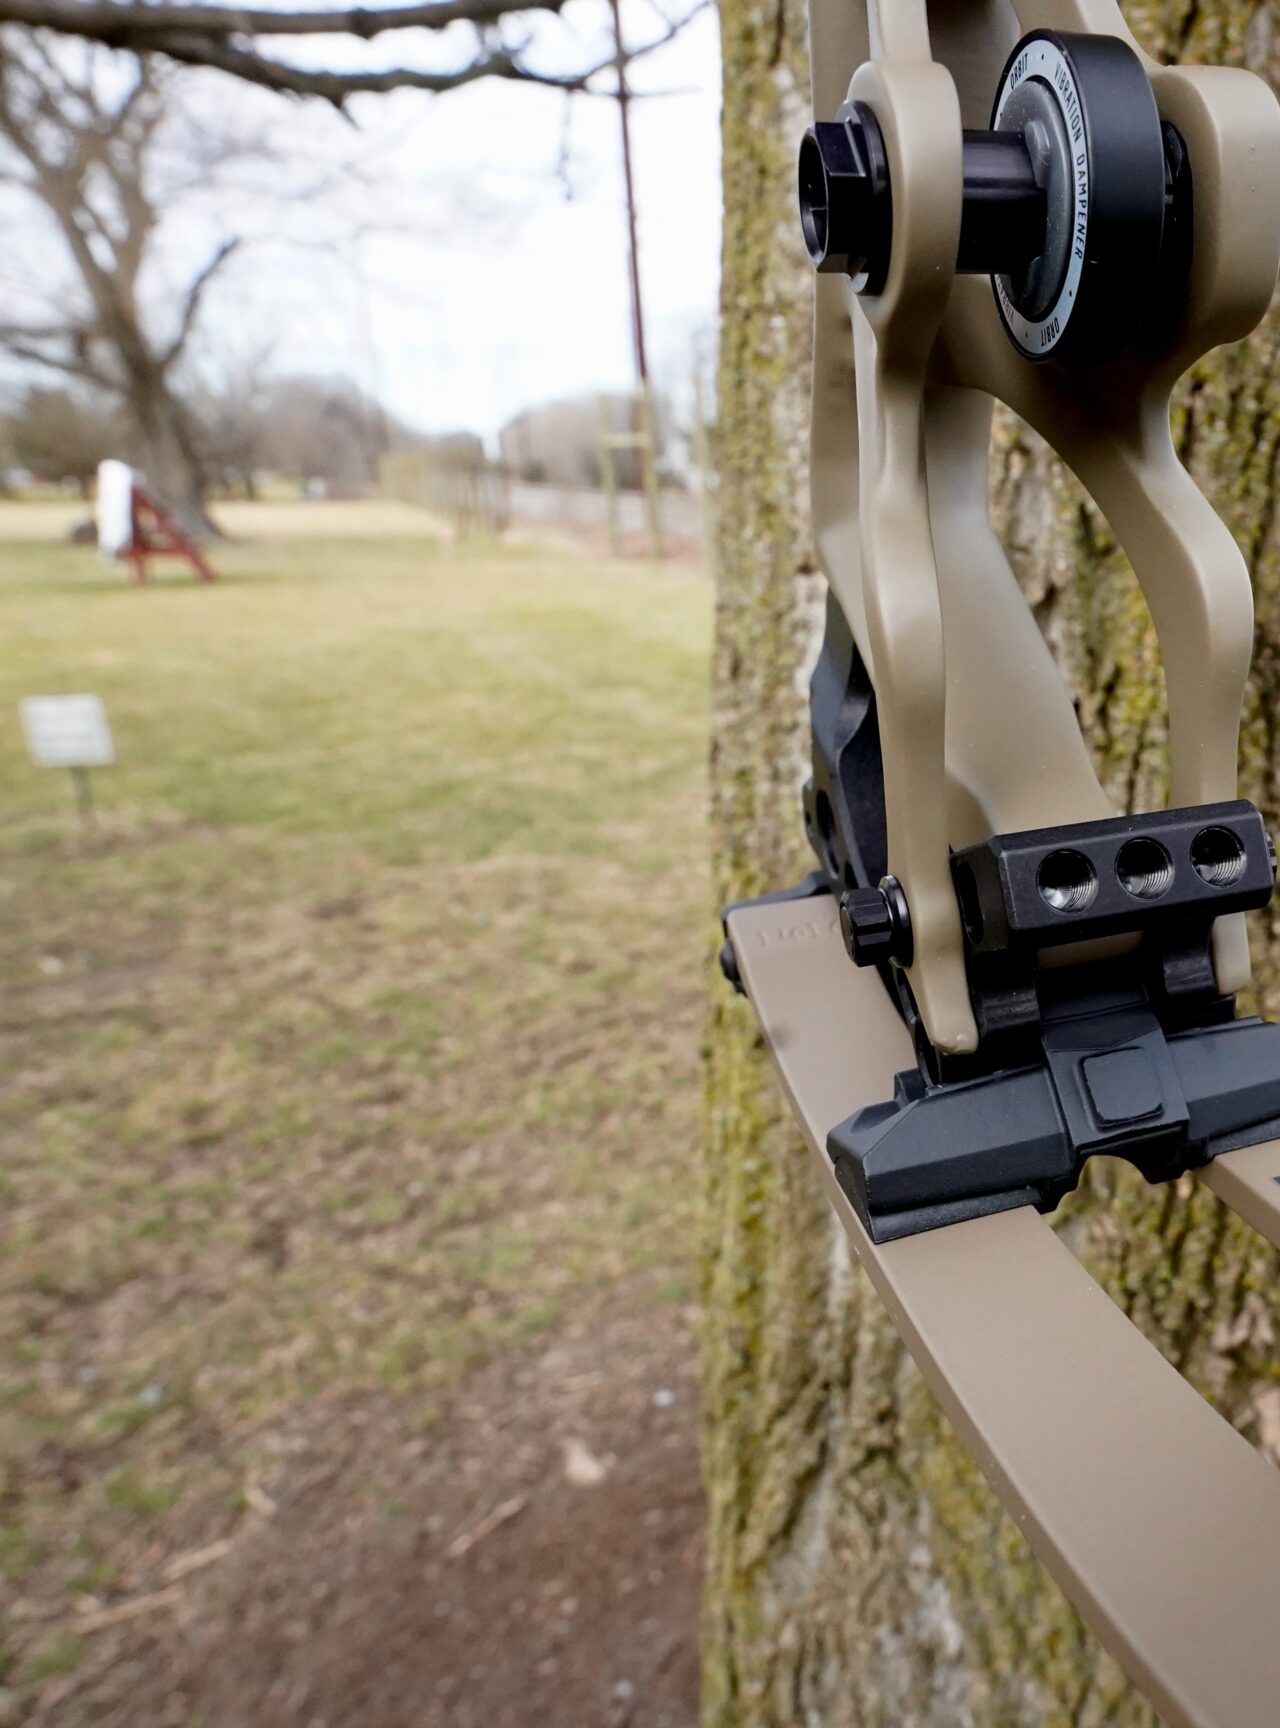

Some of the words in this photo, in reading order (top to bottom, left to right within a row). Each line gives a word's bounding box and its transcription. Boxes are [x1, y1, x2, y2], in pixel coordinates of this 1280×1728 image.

[1010, 52, 1028, 90] ORBIT
[1054, 61, 1082, 143] VIBRATION
[1074, 153, 1087, 260] DAMPENER
[1040, 317, 1060, 347] ORBIT
